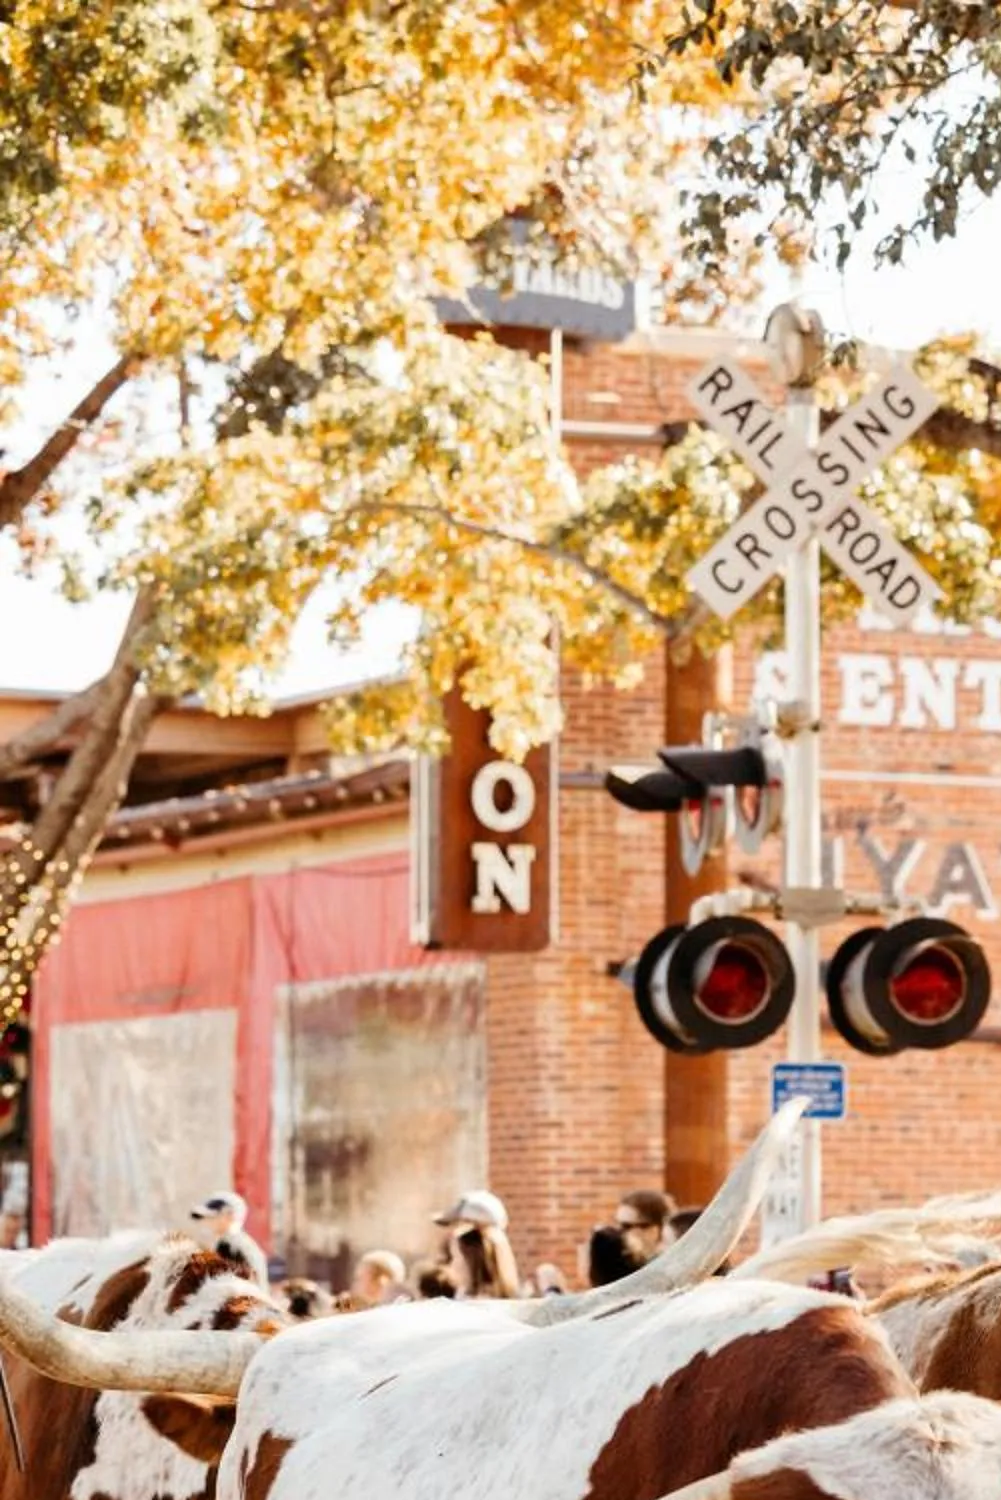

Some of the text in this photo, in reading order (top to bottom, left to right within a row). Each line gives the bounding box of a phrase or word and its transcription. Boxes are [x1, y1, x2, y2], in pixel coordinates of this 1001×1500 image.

[698, 366, 922, 610] RAIL ROAD
[711, 385, 916, 594] CROSSING
